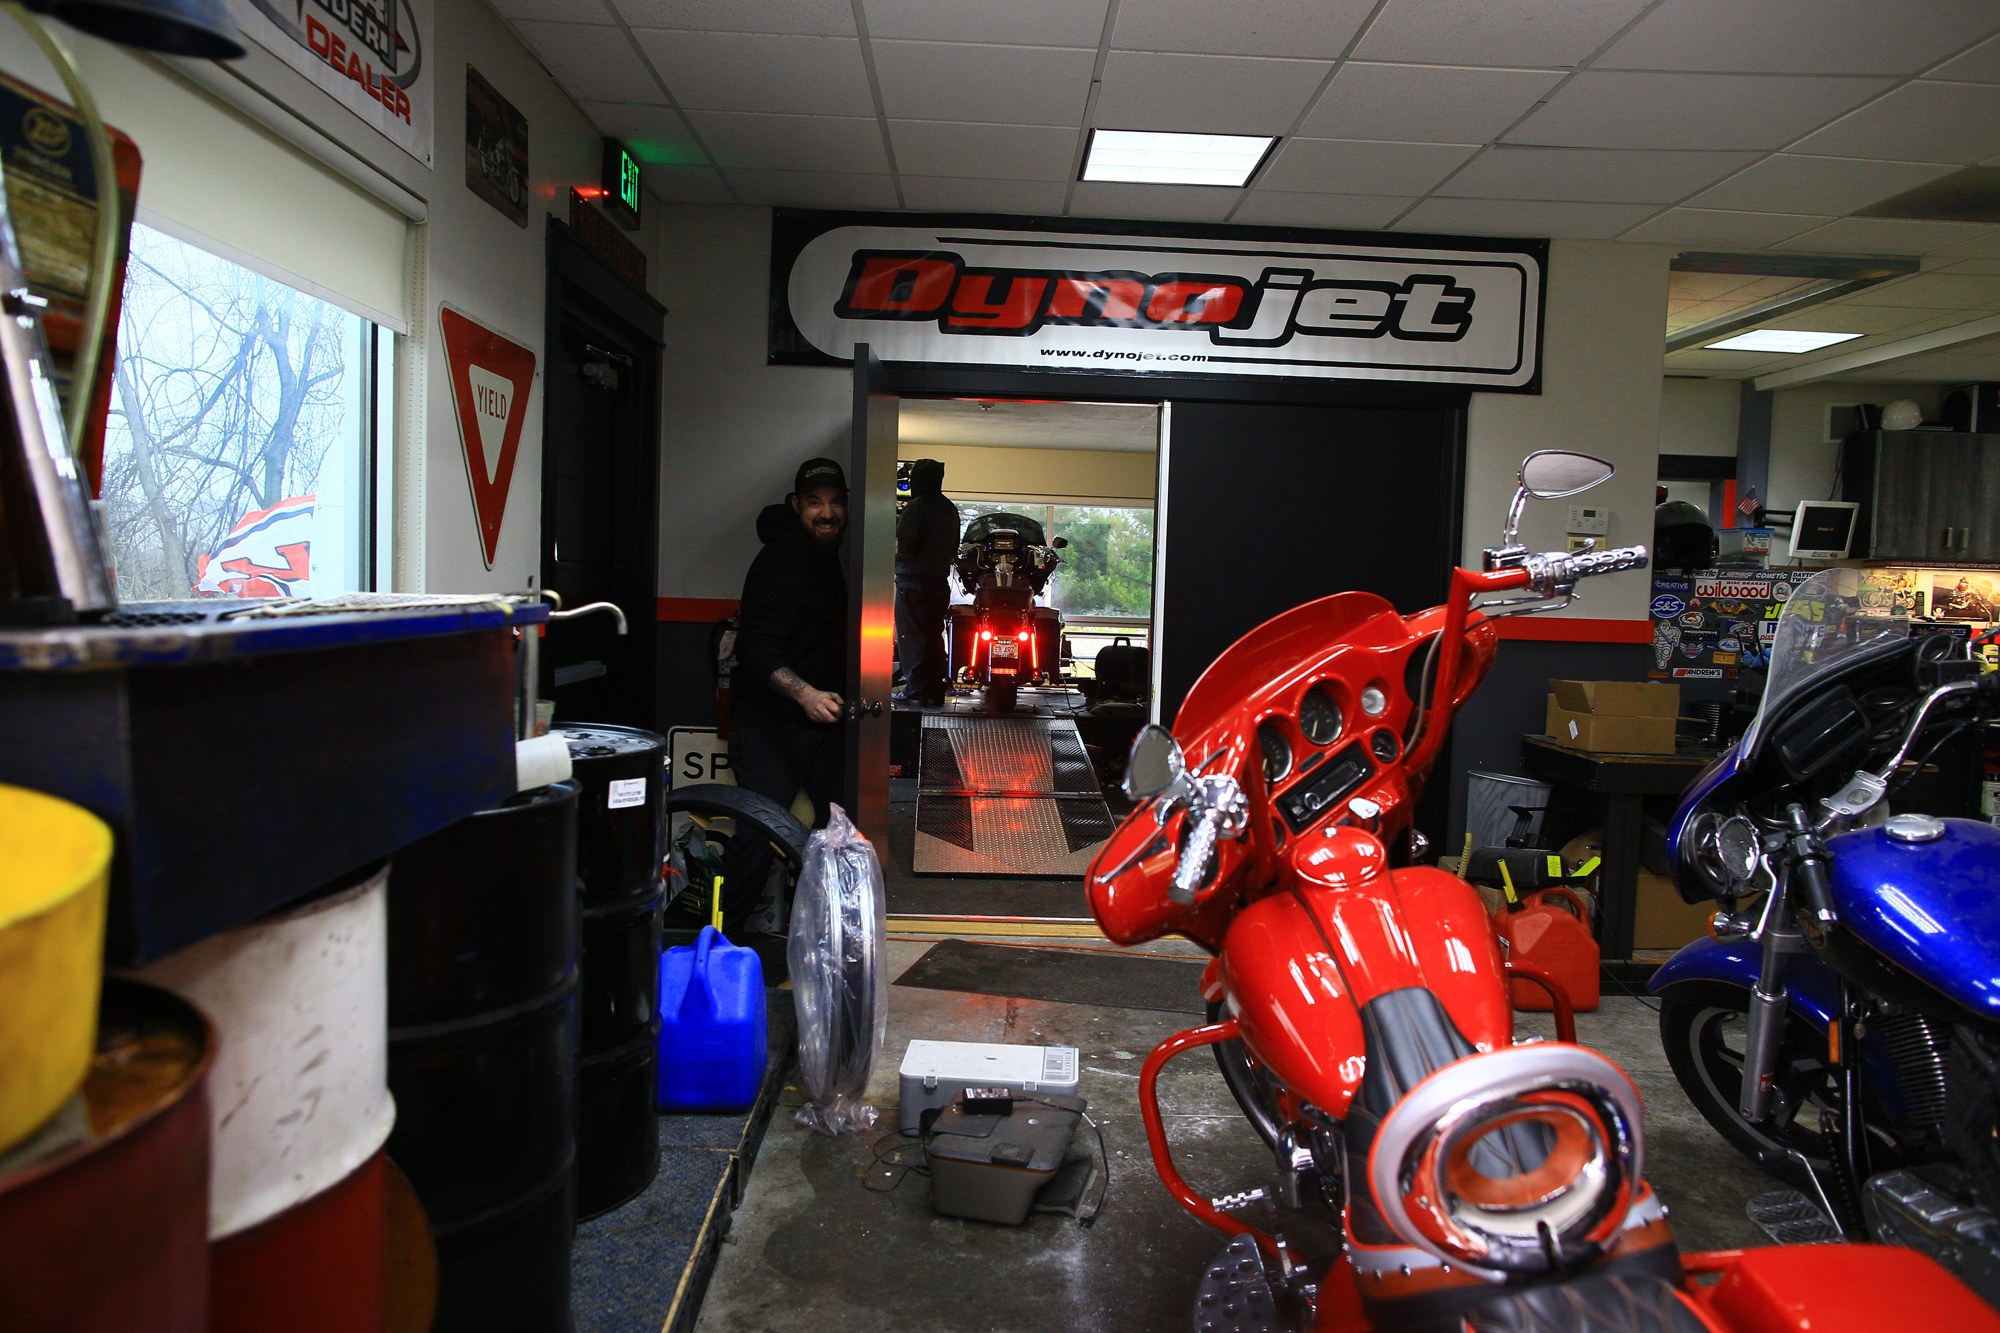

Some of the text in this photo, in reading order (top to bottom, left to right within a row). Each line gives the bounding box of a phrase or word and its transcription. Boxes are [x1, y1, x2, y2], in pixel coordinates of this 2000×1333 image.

[306, 13, 411, 126] DEALER
[621, 150, 639, 213] EXIT
[838, 250, 1472, 346] Dynojet
[1040, 349, 1208, 362] www.dynojet.com
[477, 384, 507, 420] YIELD
[1756, 572, 1788, 580] COMETIC
[1696, 581, 1770, 598] wilwood
[1653, 601, 1680, 610] S&S
